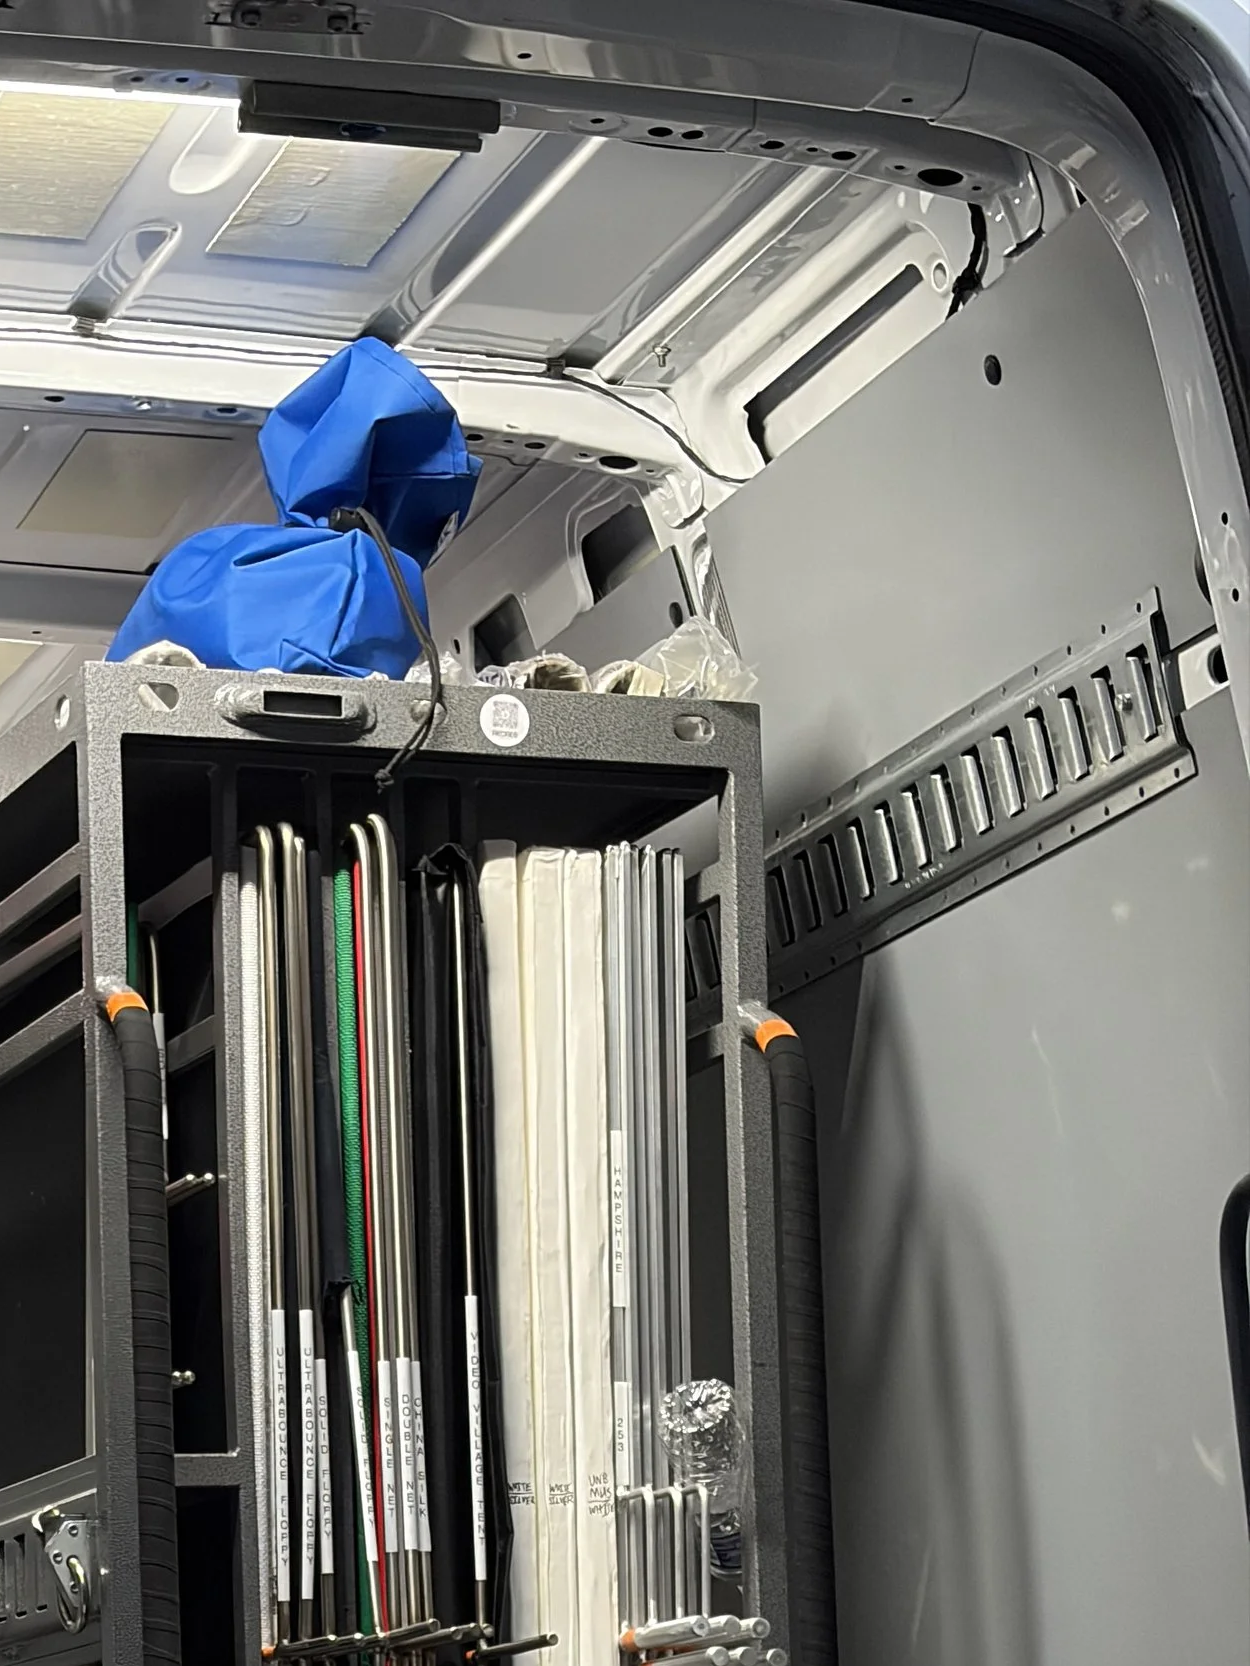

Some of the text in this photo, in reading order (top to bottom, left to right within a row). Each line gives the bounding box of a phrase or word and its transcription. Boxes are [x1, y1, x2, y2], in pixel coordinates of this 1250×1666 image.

[613, 1167, 623, 1273] HAMPSHIRE
[276, 1347, 289, 1566] ULTRABOUNCE FLOPPY
[303, 1347, 315, 1565] ULTRABOUNCE FLOPPY
[318, 1395, 332, 1537] SOLID FLOPPY
[356, 1386, 375, 1526] SOLID FLOPPY
[383, 1397, 395, 1518] SINGLE NET
[401, 1394, 415, 1515] DOUBLE NET
[413, 1397, 427, 1517] CHINA SILK
[470, 1331, 486, 1547] VIDEO VILLAGE TENT
[617, 1417, 625, 1452] 253
[548, 1494, 575, 1507] SILVER
